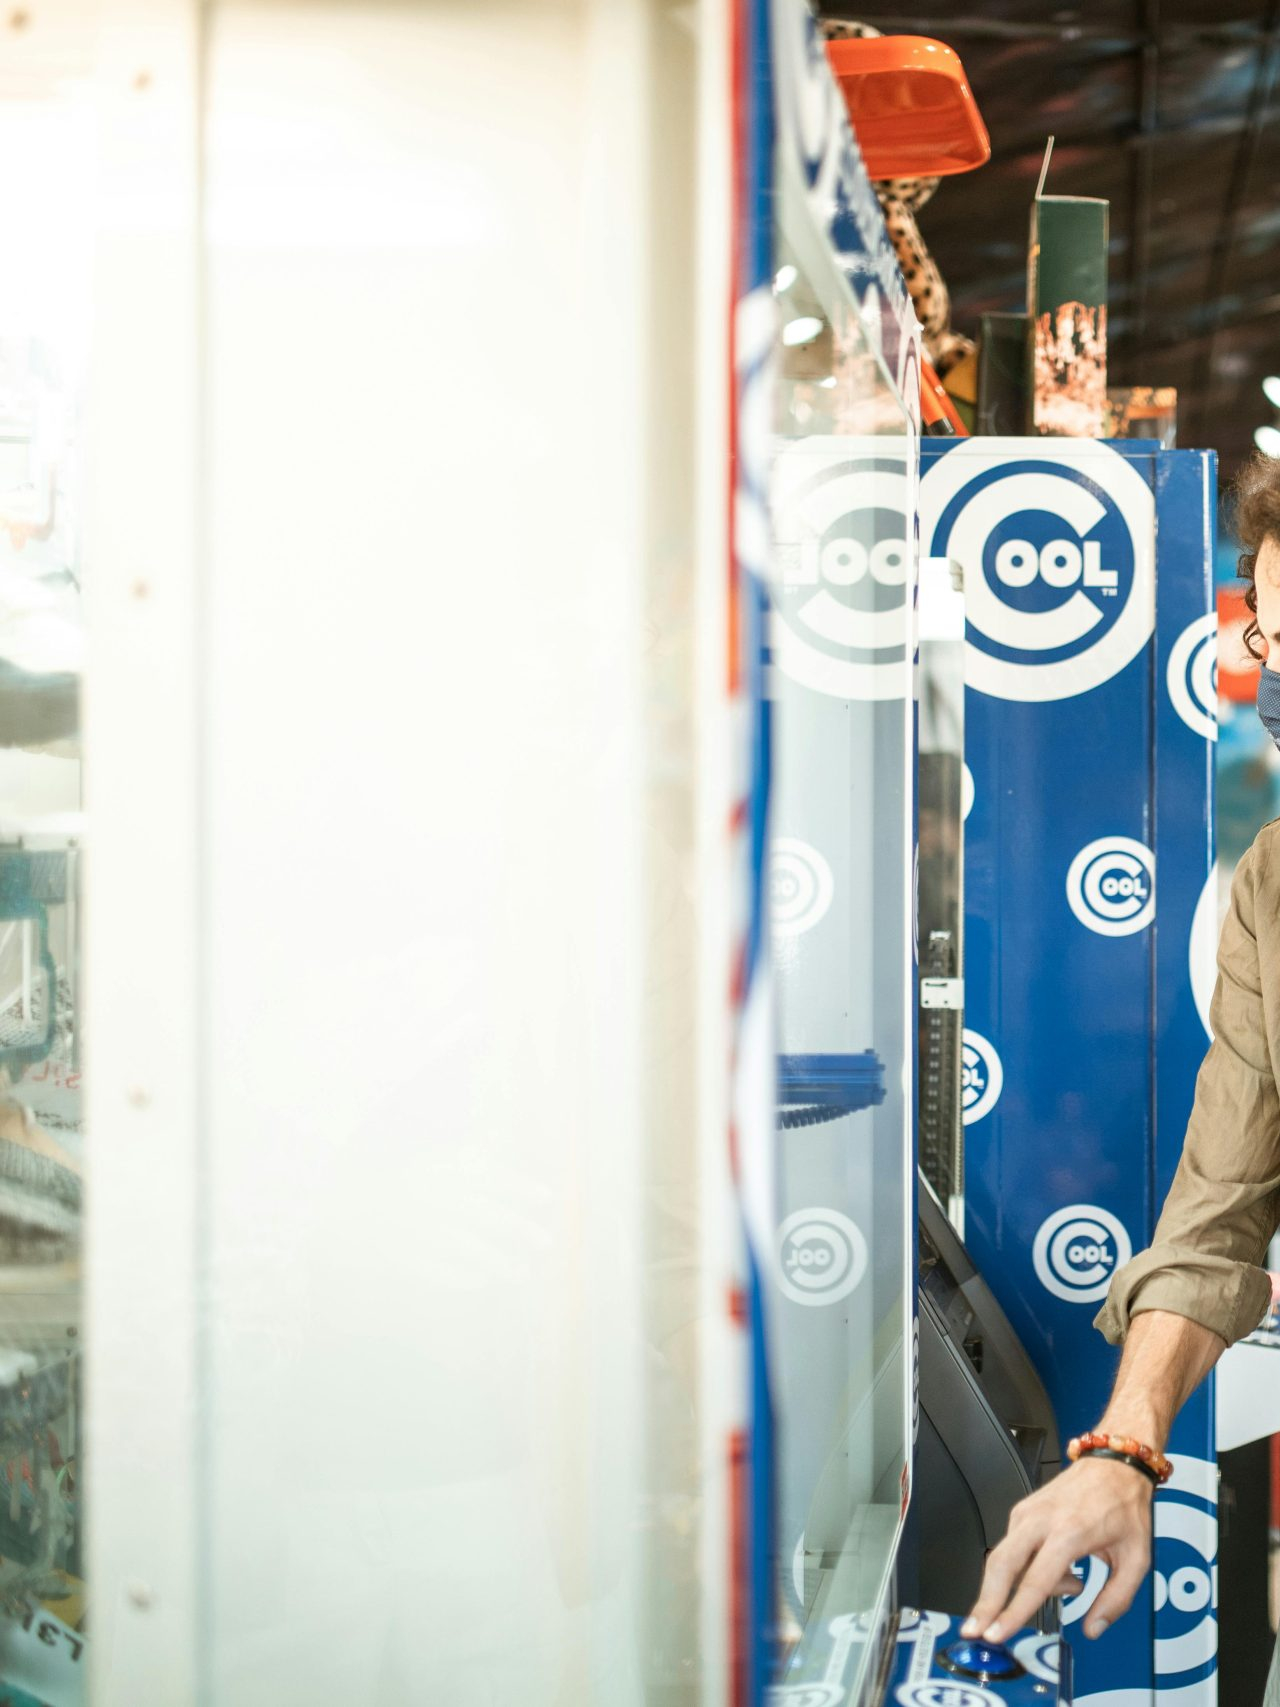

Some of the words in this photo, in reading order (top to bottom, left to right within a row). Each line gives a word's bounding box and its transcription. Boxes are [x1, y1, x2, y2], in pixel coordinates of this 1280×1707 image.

[946, 472, 1118, 650] COOL
[1084, 854, 1147, 918] COOL
[1050, 1222, 1113, 1285] COOL
